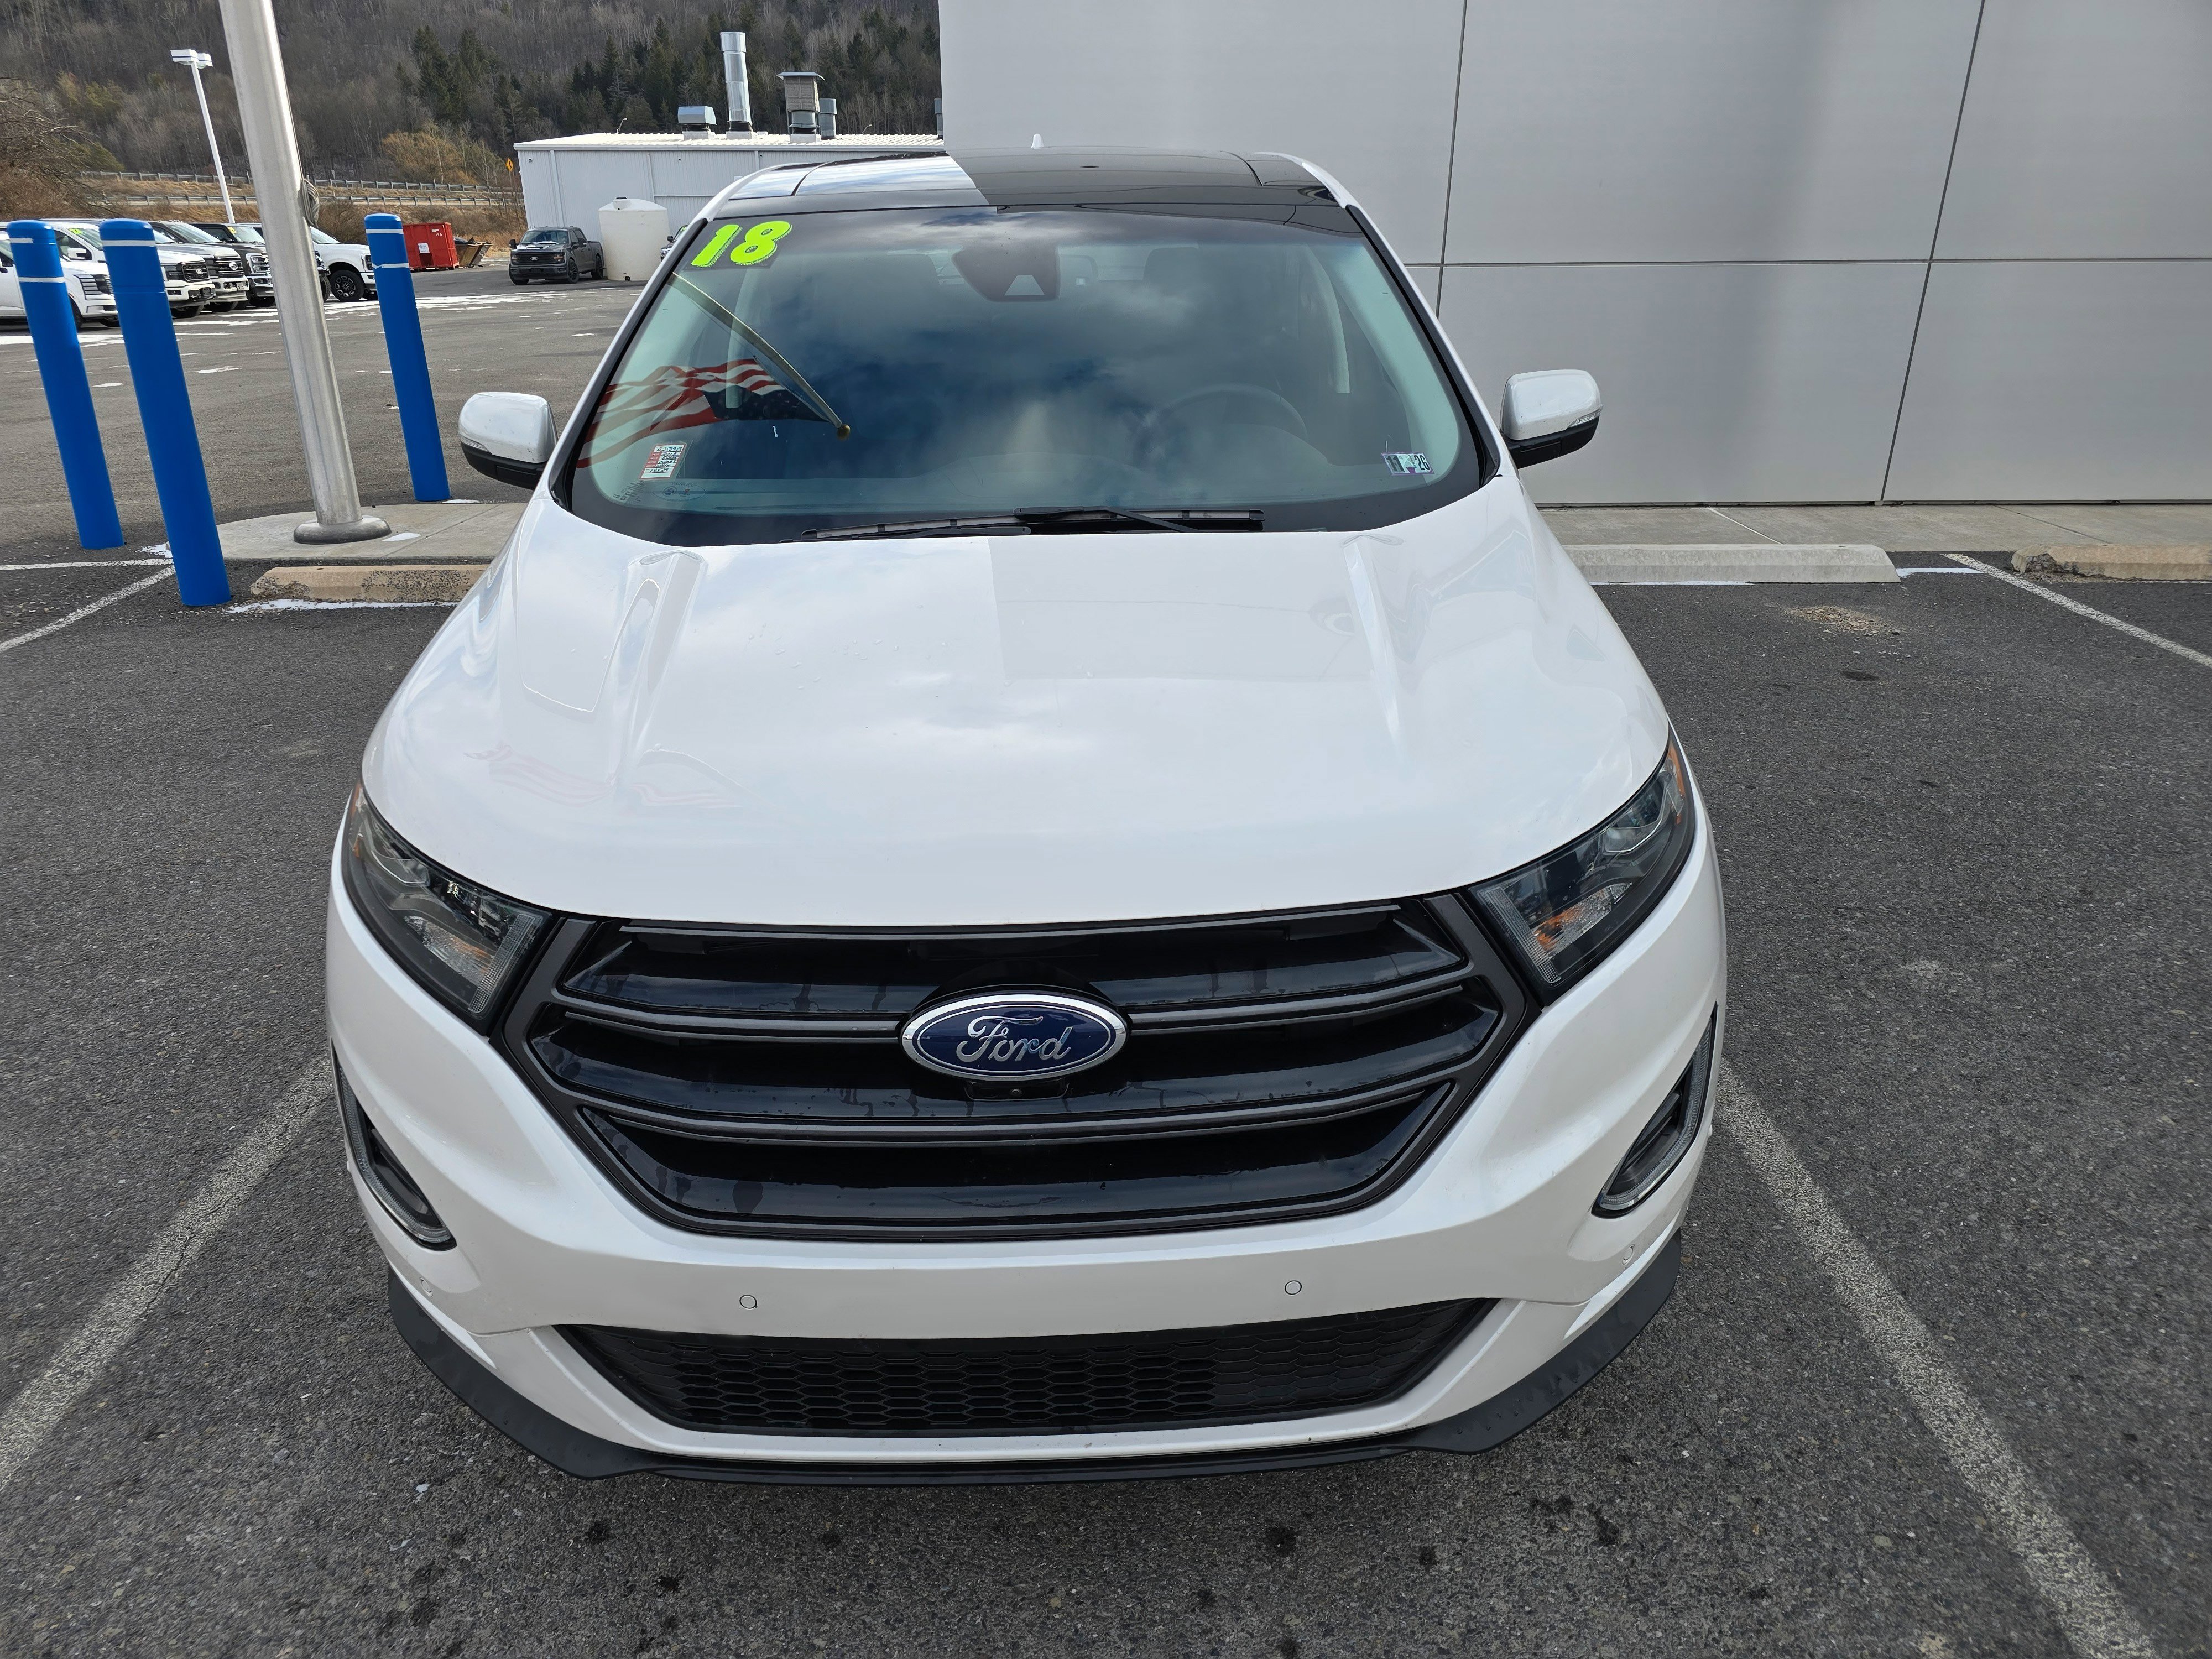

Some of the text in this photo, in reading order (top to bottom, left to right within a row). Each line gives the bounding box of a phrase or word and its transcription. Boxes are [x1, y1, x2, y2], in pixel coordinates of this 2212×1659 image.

[691, 221, 792, 267] 18
[1386, 456, 1405, 472] 11
[1414, 455, 1430, 471] 26
[956, 1015, 1073, 1062] Ford
